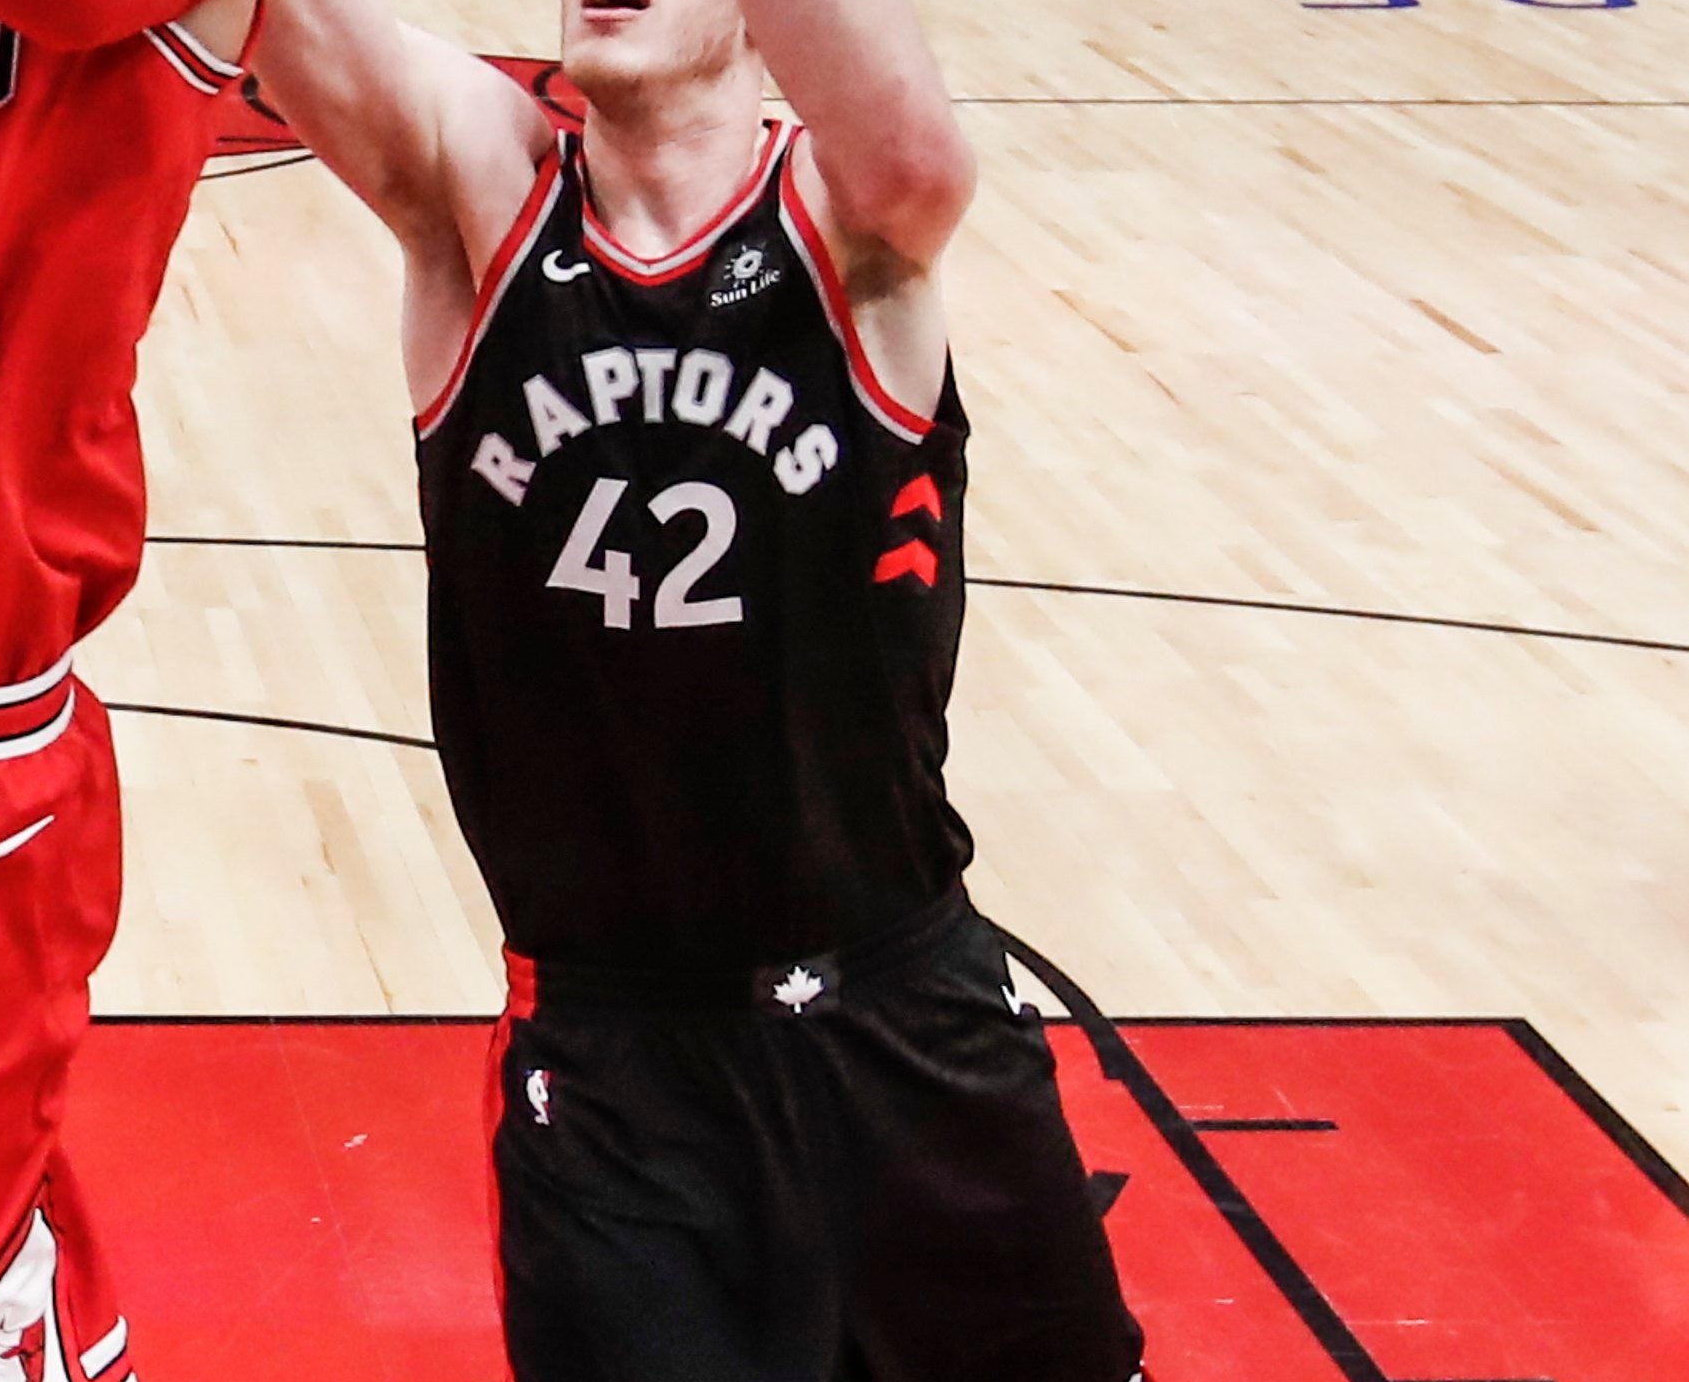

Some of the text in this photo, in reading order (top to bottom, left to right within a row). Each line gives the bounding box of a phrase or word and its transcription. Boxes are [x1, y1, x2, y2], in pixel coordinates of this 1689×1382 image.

[710, 268, 781, 308] Sun Life
[471, 345, 839, 507] RAPTORS
[545, 476, 744, 630] 42
